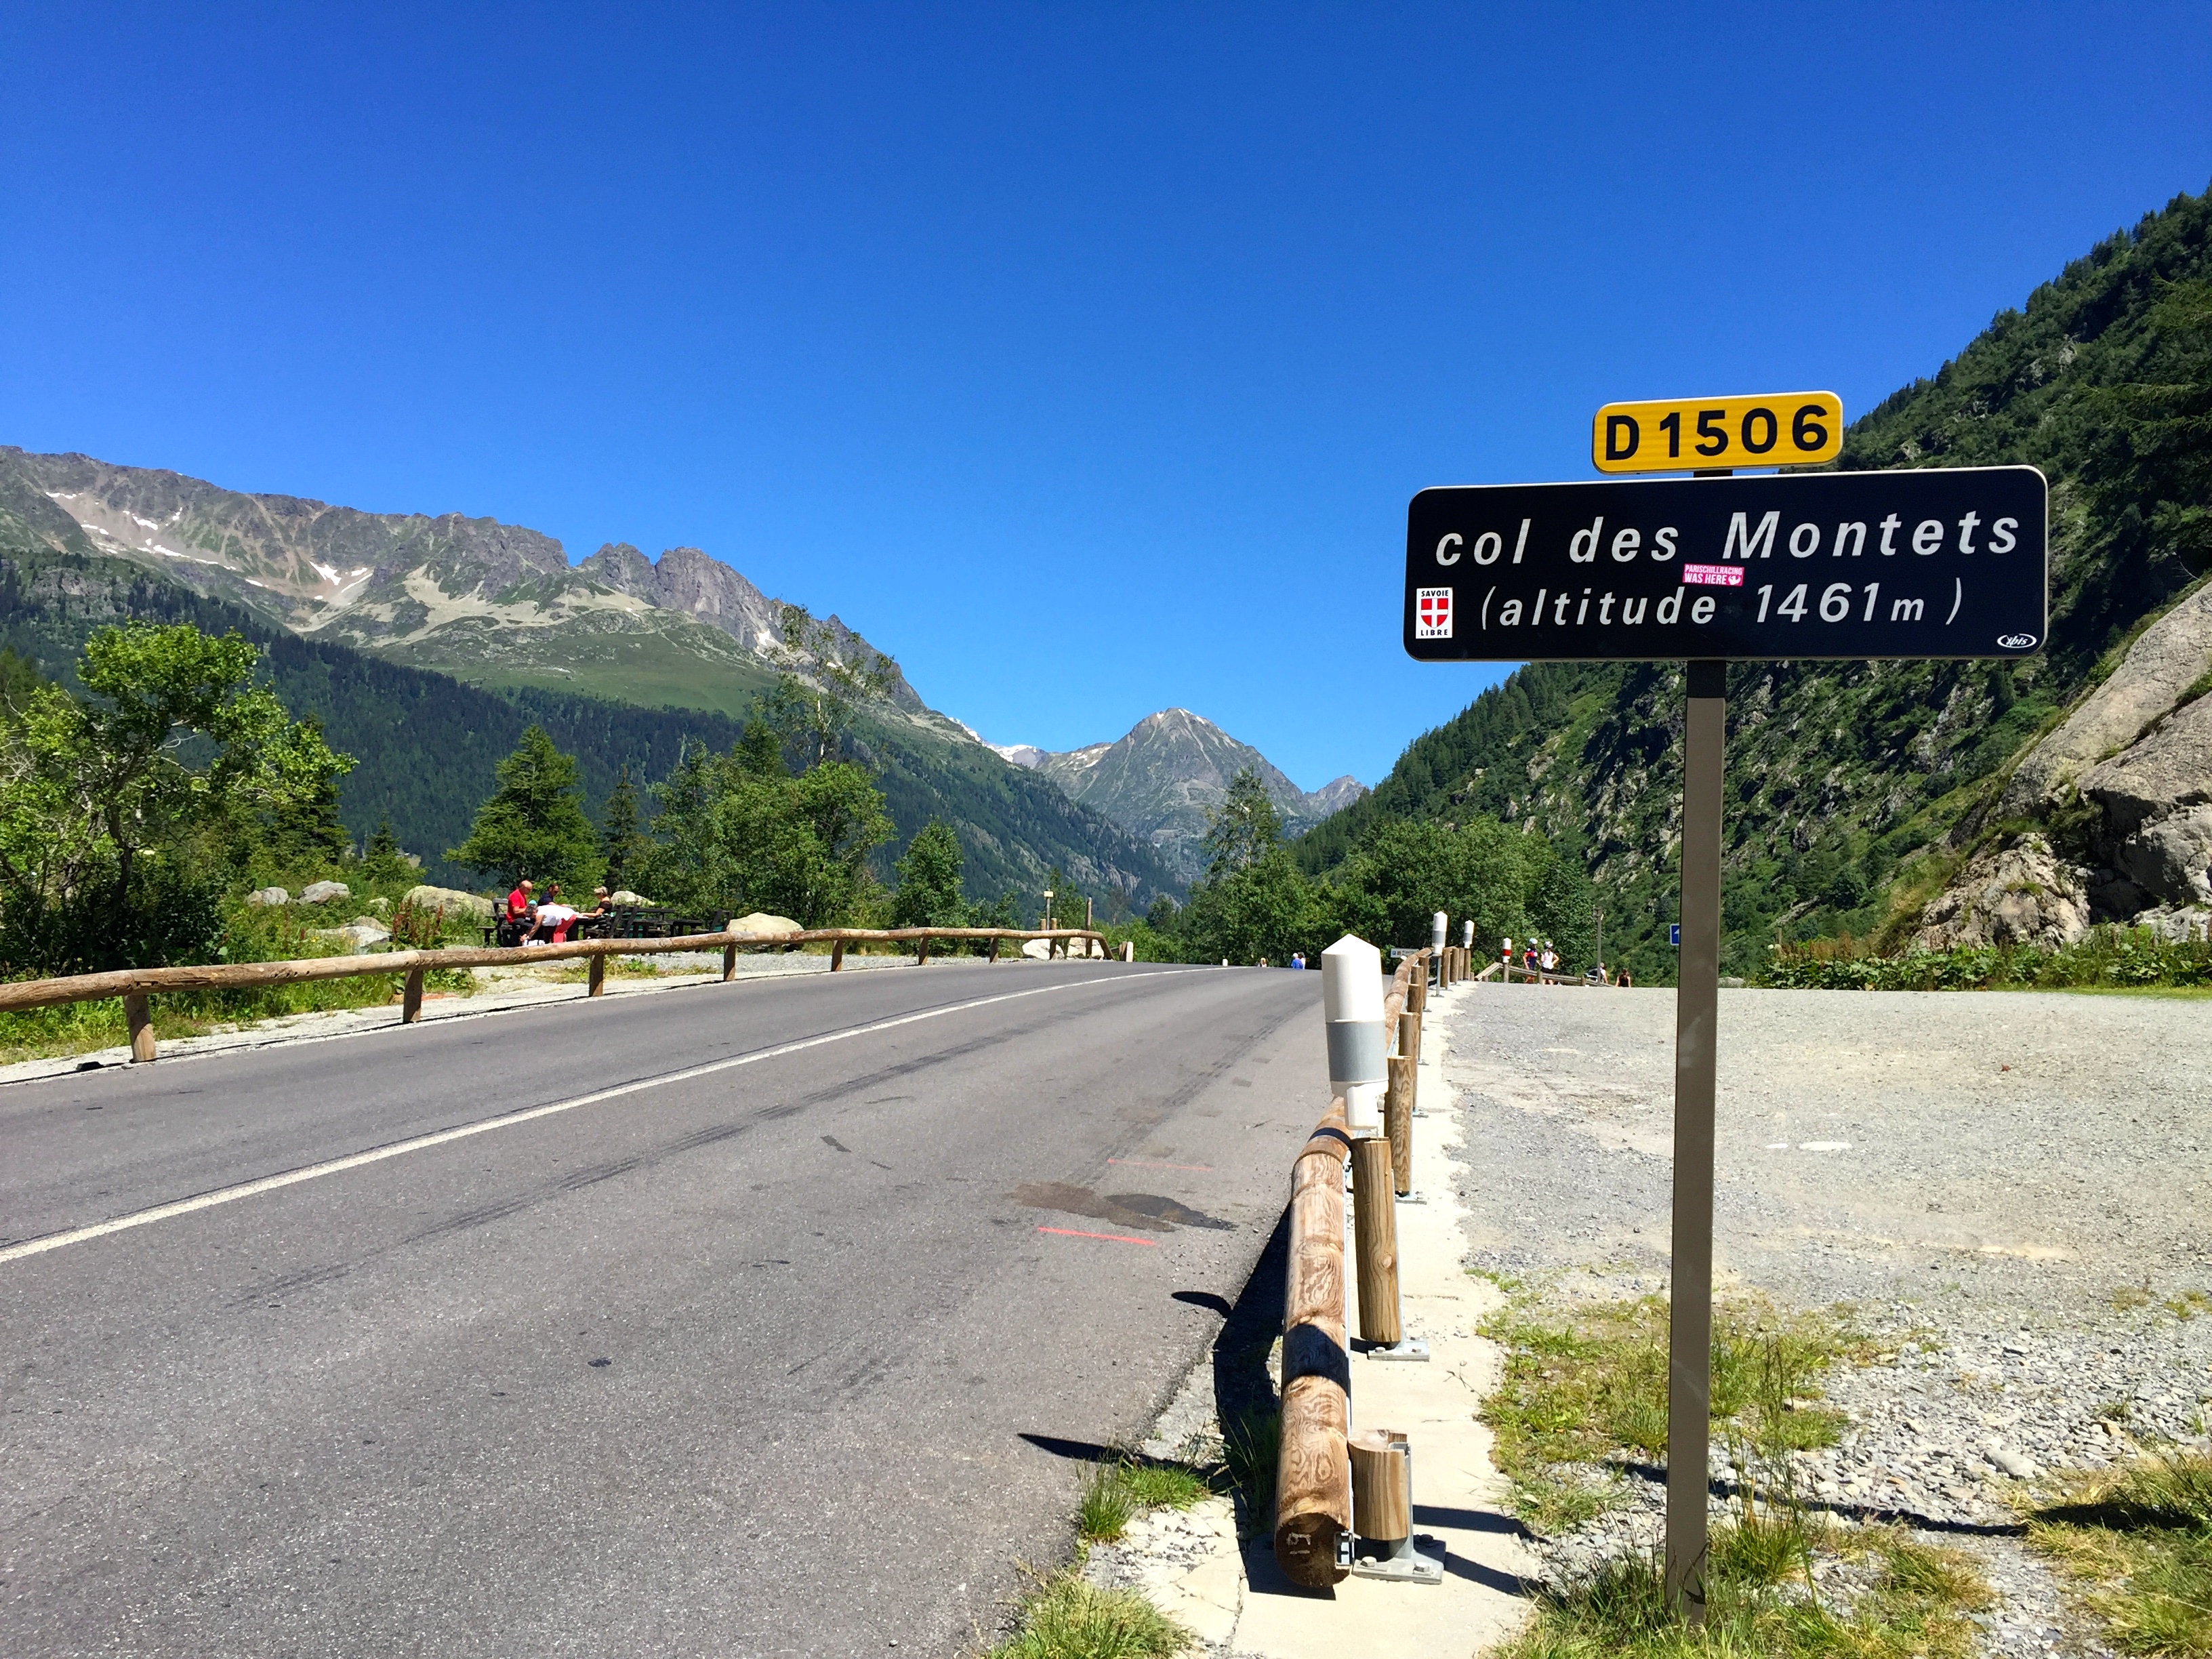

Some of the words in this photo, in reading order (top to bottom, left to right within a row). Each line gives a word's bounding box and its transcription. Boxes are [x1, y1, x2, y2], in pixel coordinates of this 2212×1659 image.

[1605, 414, 1640, 461] D
[1658, 404, 1828, 458] 1506
[1435, 518, 1532, 566] col
[1568, 515, 1679, 564] des
[1721, 510, 2020, 559] Montets
[1684, 573, 1703, 583] WAS
[1704, 574, 1727, 585] HERE
[1481, 585, 1717, 630] (altitude
